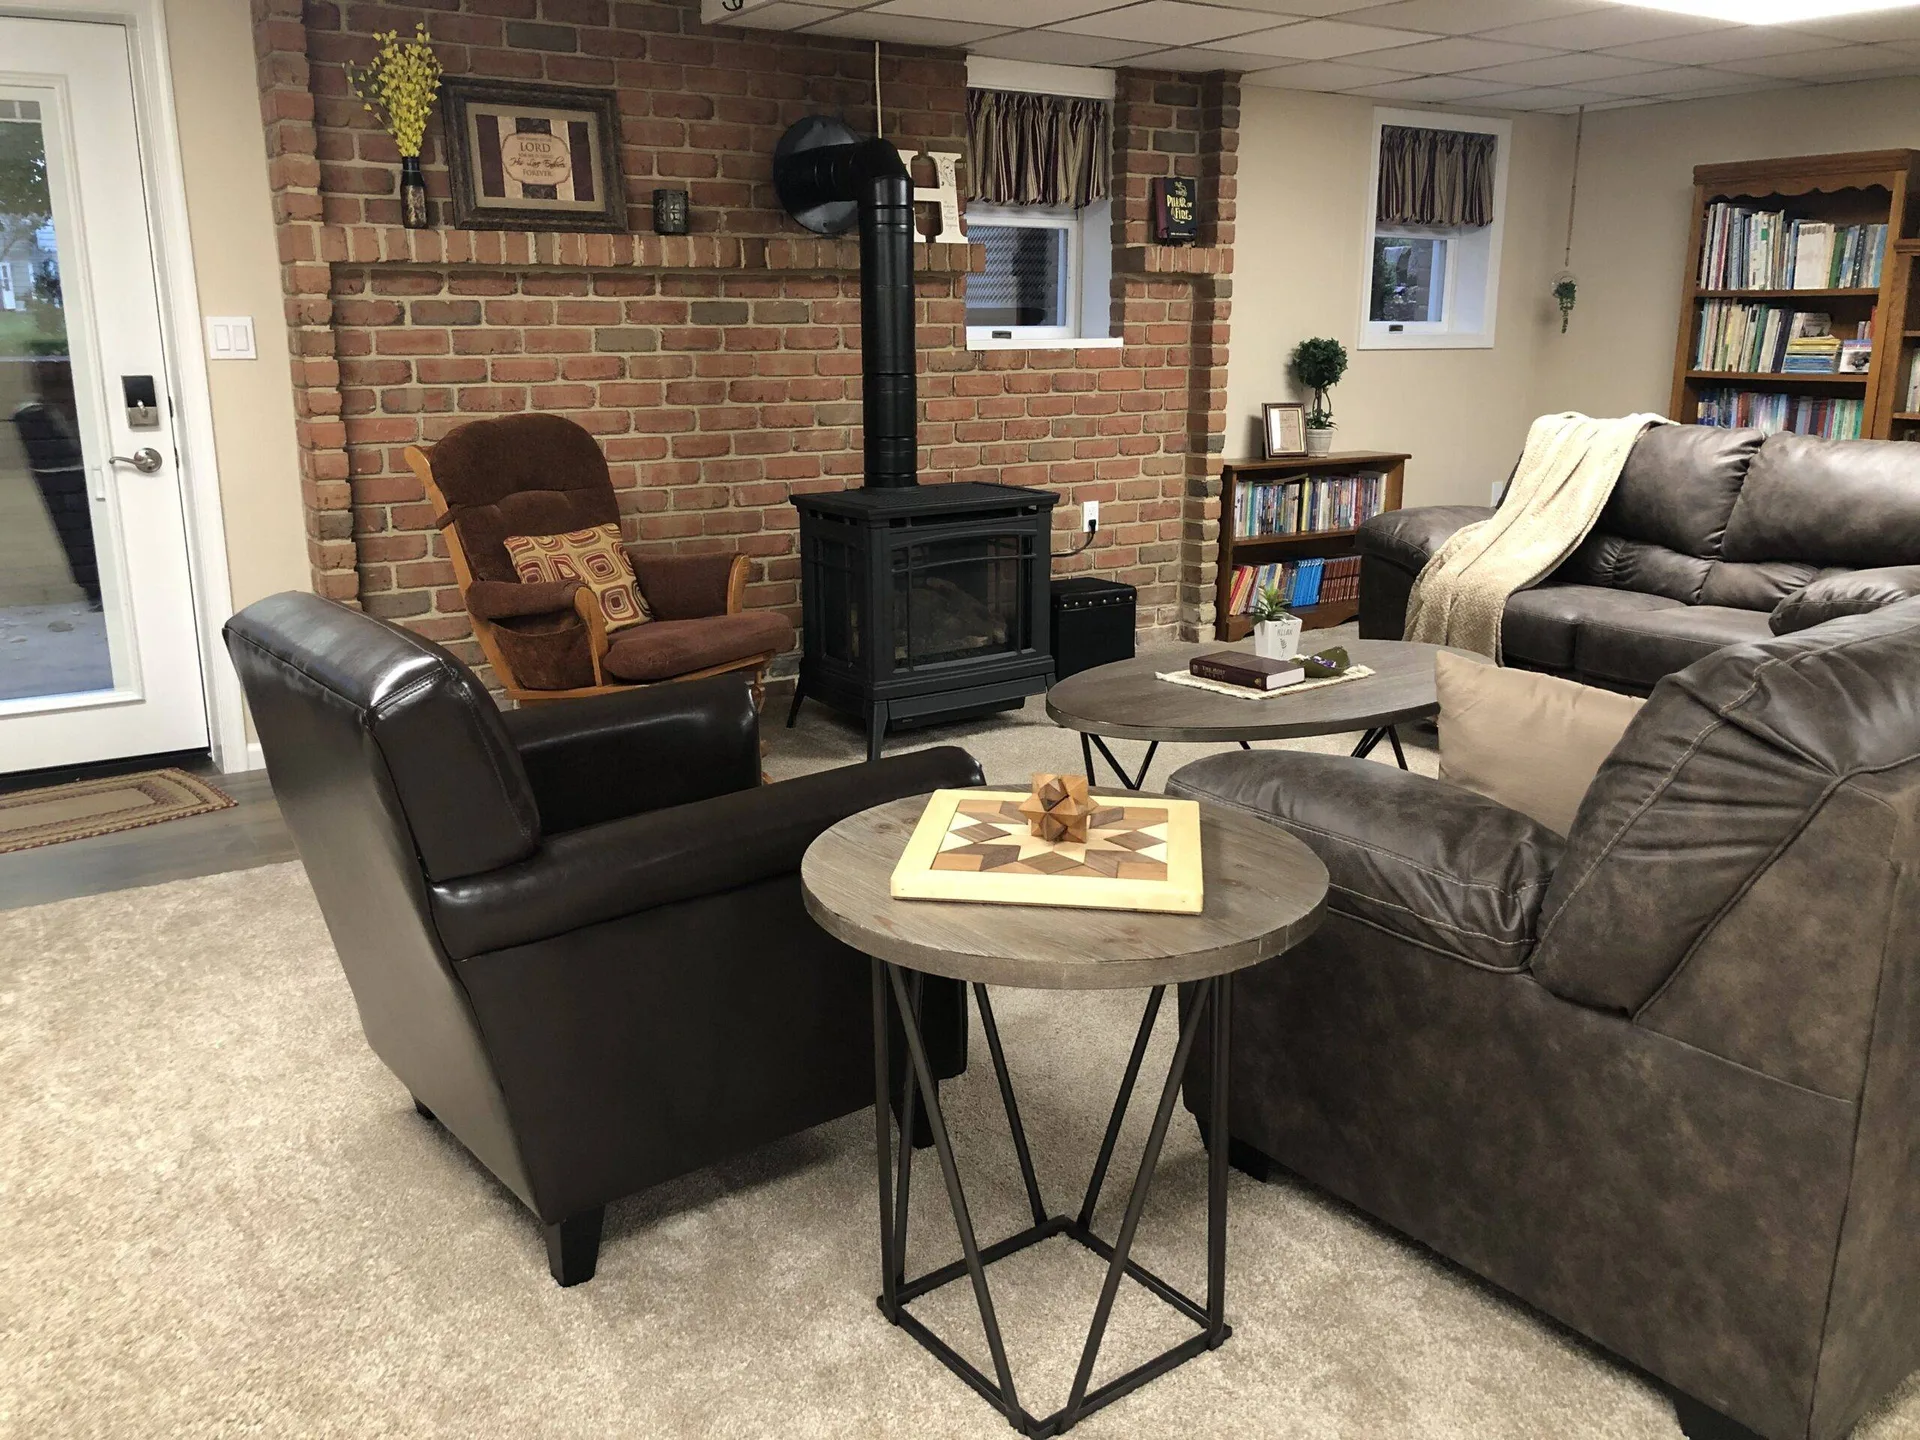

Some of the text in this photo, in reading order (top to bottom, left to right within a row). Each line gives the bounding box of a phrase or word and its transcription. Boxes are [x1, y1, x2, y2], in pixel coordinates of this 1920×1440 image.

[520, 142, 551, 152] LORD
[1166, 194, 1187, 208] PILLAR
[1175, 208, 1193, 220] FIRE
